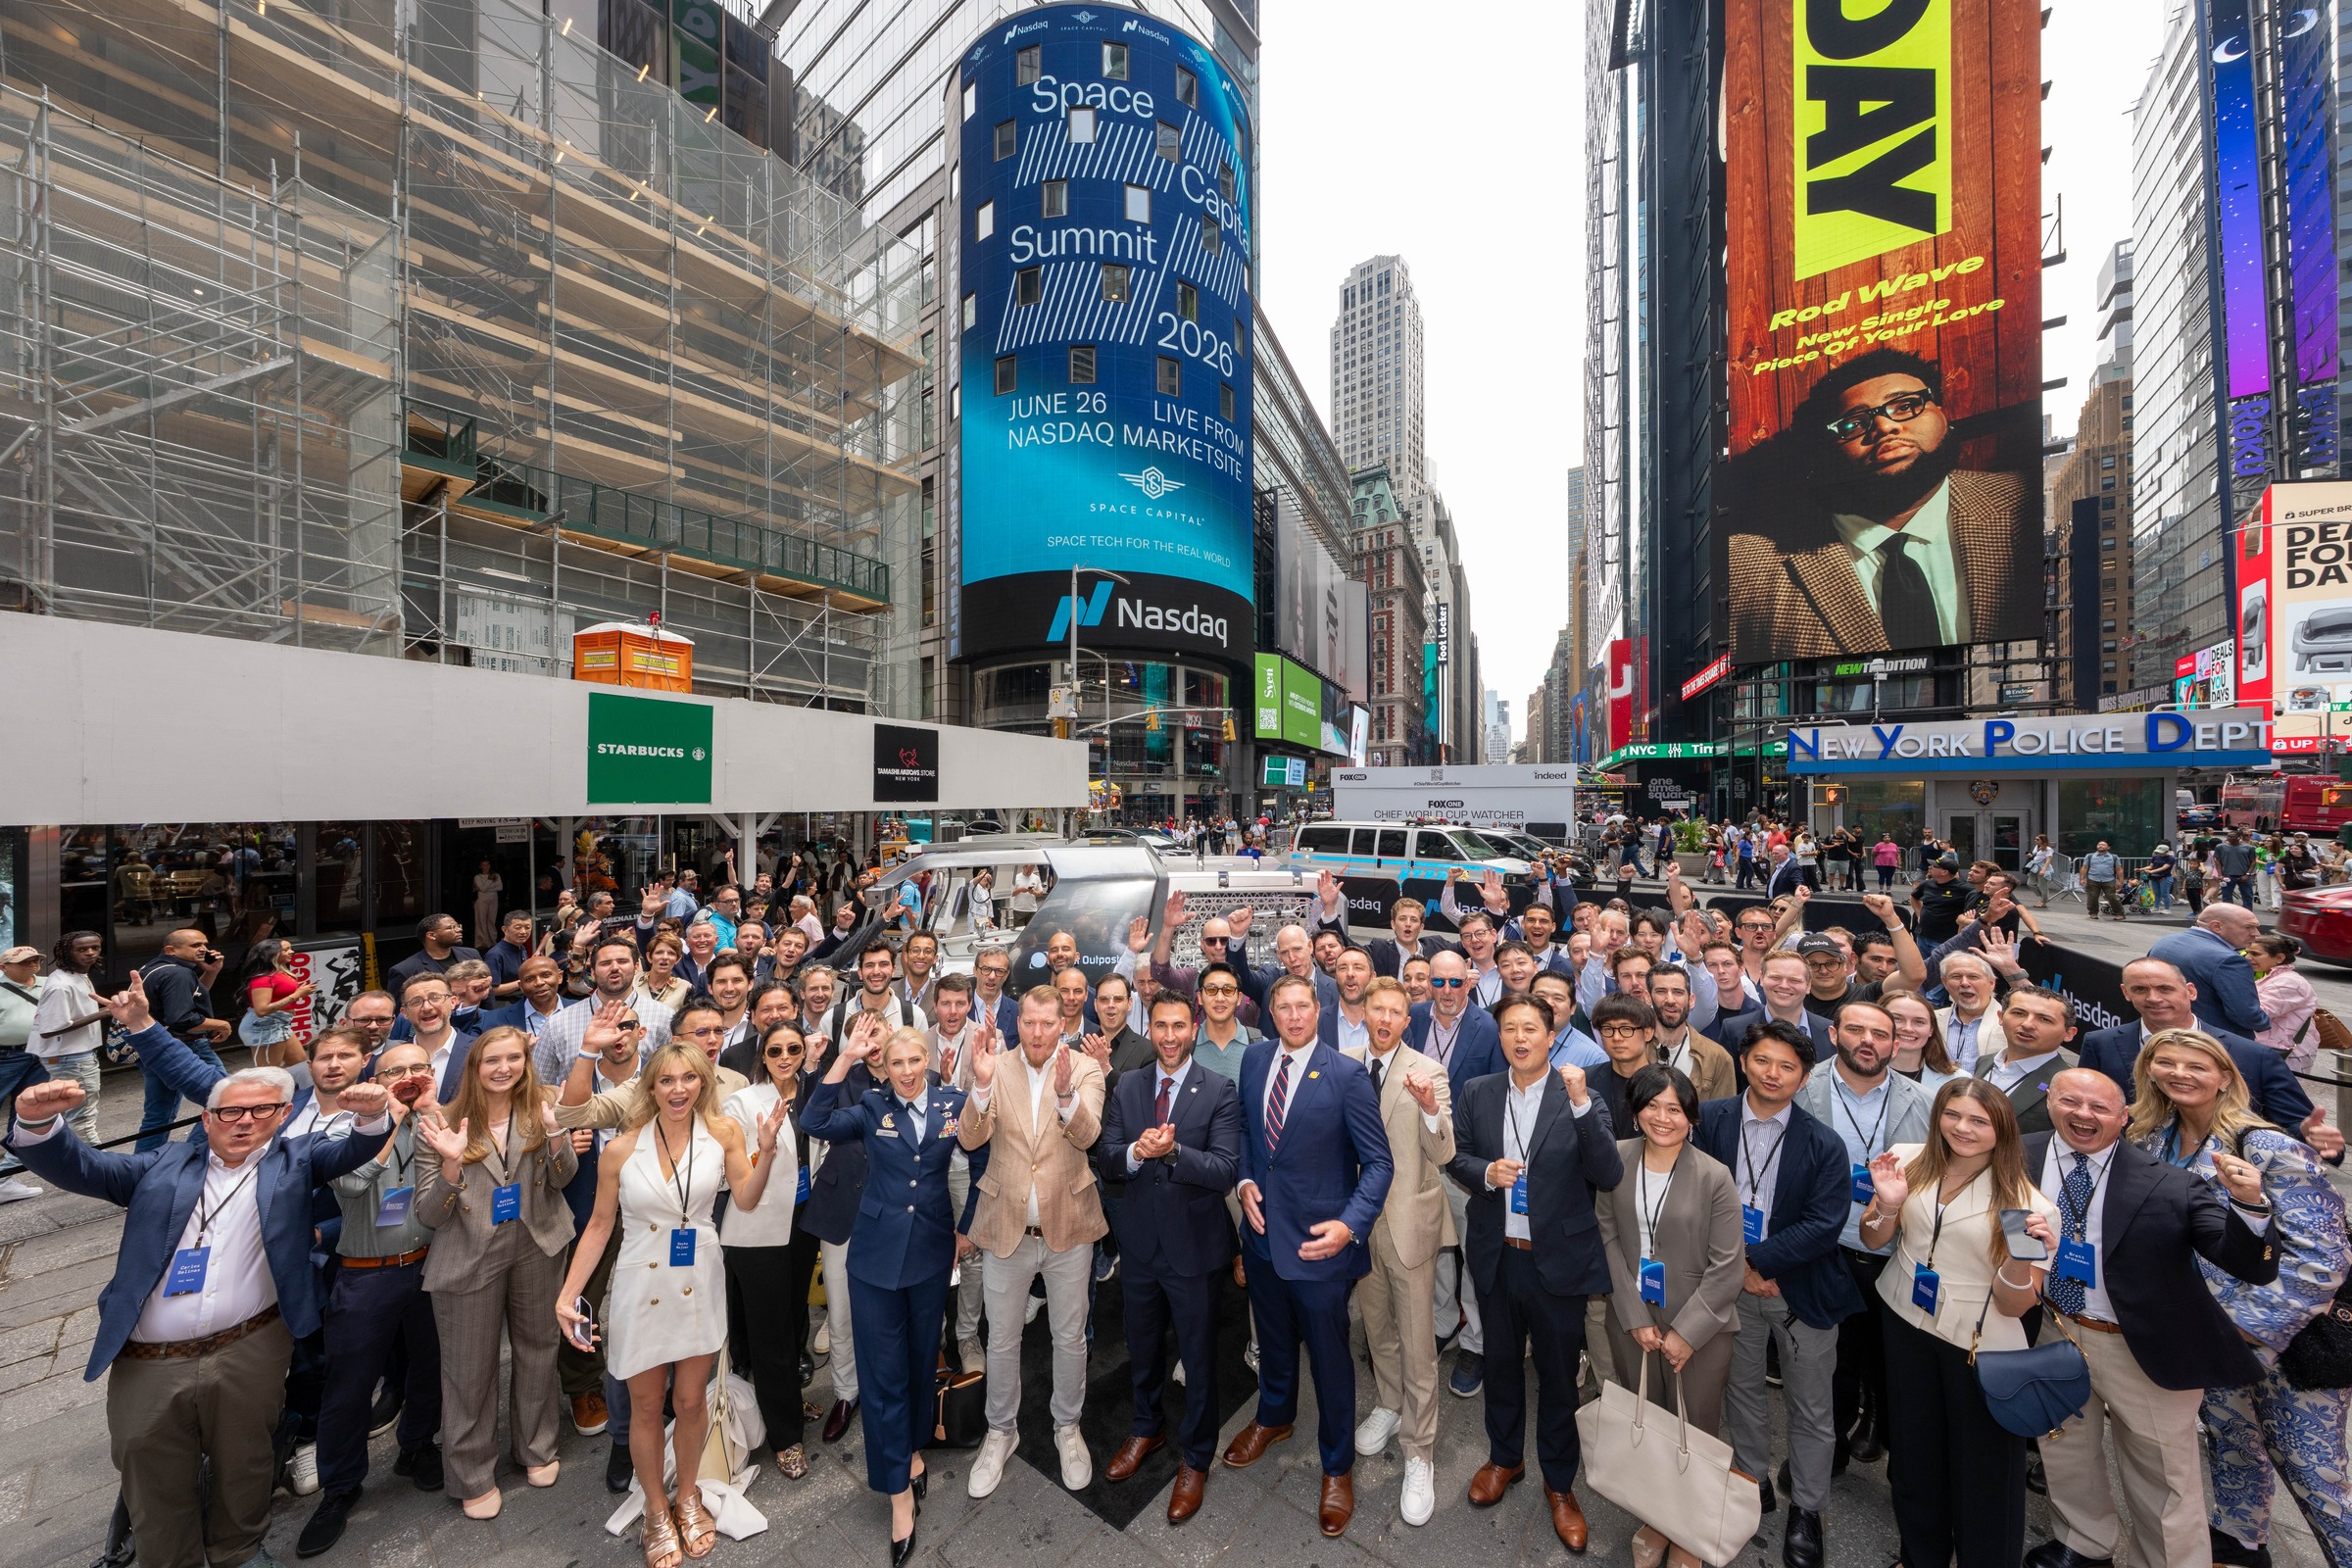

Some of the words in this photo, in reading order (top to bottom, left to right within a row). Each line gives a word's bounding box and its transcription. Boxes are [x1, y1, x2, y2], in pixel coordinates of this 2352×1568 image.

[1017, 20, 1049, 35] Nasdaq
[1138, 24, 1170, 46] Nasdaq
[1032, 75, 1154, 119] Space
[1010, 224, 1157, 264] Summit
[1768, 291, 1851, 331] Rod
[1858, 256, 1984, 304] Wave
[1796, 324, 1857, 350] New
[1859, 298, 1951, 331] Single
[1157, 311, 1234, 378] 2026
[1752, 349, 1819, 375] Piece
[1823, 335, 1859, 356] Of
[1862, 320, 1929, 345] Your
[1931, 298, 2005, 326] Love
[1008, 393, 1067, 421] JUNE
[1076, 392, 1107, 415] 26
[1153, 400, 1199, 431] LIVE
[1204, 416, 1245, 458] FROM
[1008, 421, 1114, 450] NASDAQ
[1123, 424, 1243, 482] MARKETSITE
[1090, 503, 1137, 514] SPACE
[1146, 508, 1202, 526] CAPITAL
[2298, 508, 2334, 517] SUPER
[1048, 536, 1087, 548] SPACE
[1090, 535, 1123, 548] TECH
[1126, 537, 1151, 550] FOR
[1152, 540, 1174, 553] THE
[1177, 544, 1201, 559] REAL
[1202, 550, 1231, 568] WORLD
[2286, 543, 2352, 569] FO
[2286, 564, 2352, 590] DA
[1118, 598, 1228, 648] Nasdaq
[1439, 605, 1447, 639] Locker
[1439, 641, 1447, 662] Foot
[2211, 642, 2232, 662] DEALS
[1835, 658, 1928, 675] NEWTDITION
[2211, 661, 2226, 676] FOR
[1264, 667, 1274, 698] Sven
[2211, 675, 2227, 689] YOU
[2098, 697, 2117, 712] MASS
[2118, 685, 2170, 708] SURVEILLANCE
[2211, 688, 2230, 703] DAYS
[1789, 728, 1867, 761] NEW
[1872, 724, 1973, 760] YORK
[1985, 719, 2124, 758] POLICE
[2146, 712, 2277, 753] DEPT
[2290, 740, 2314, 749] UP
[597, 743, 684, 759] STARBUCKS
[1629, 746, 1657, 756] NYC
[1113, 760, 1139, 768] Nasdaq
[1534, 770, 1567, 780] indeed
[1428, 800, 1447, 808] FOX
[1647, 791, 1690, 802] square
[1404, 810, 1443, 819] WORLD
[1446, 810, 1468, 819] CUP
[1471, 810, 1524, 819] WATCHER
[1398, 868, 1447, 880] NYPD
[290, 953, 313, 1046] CHICGO
